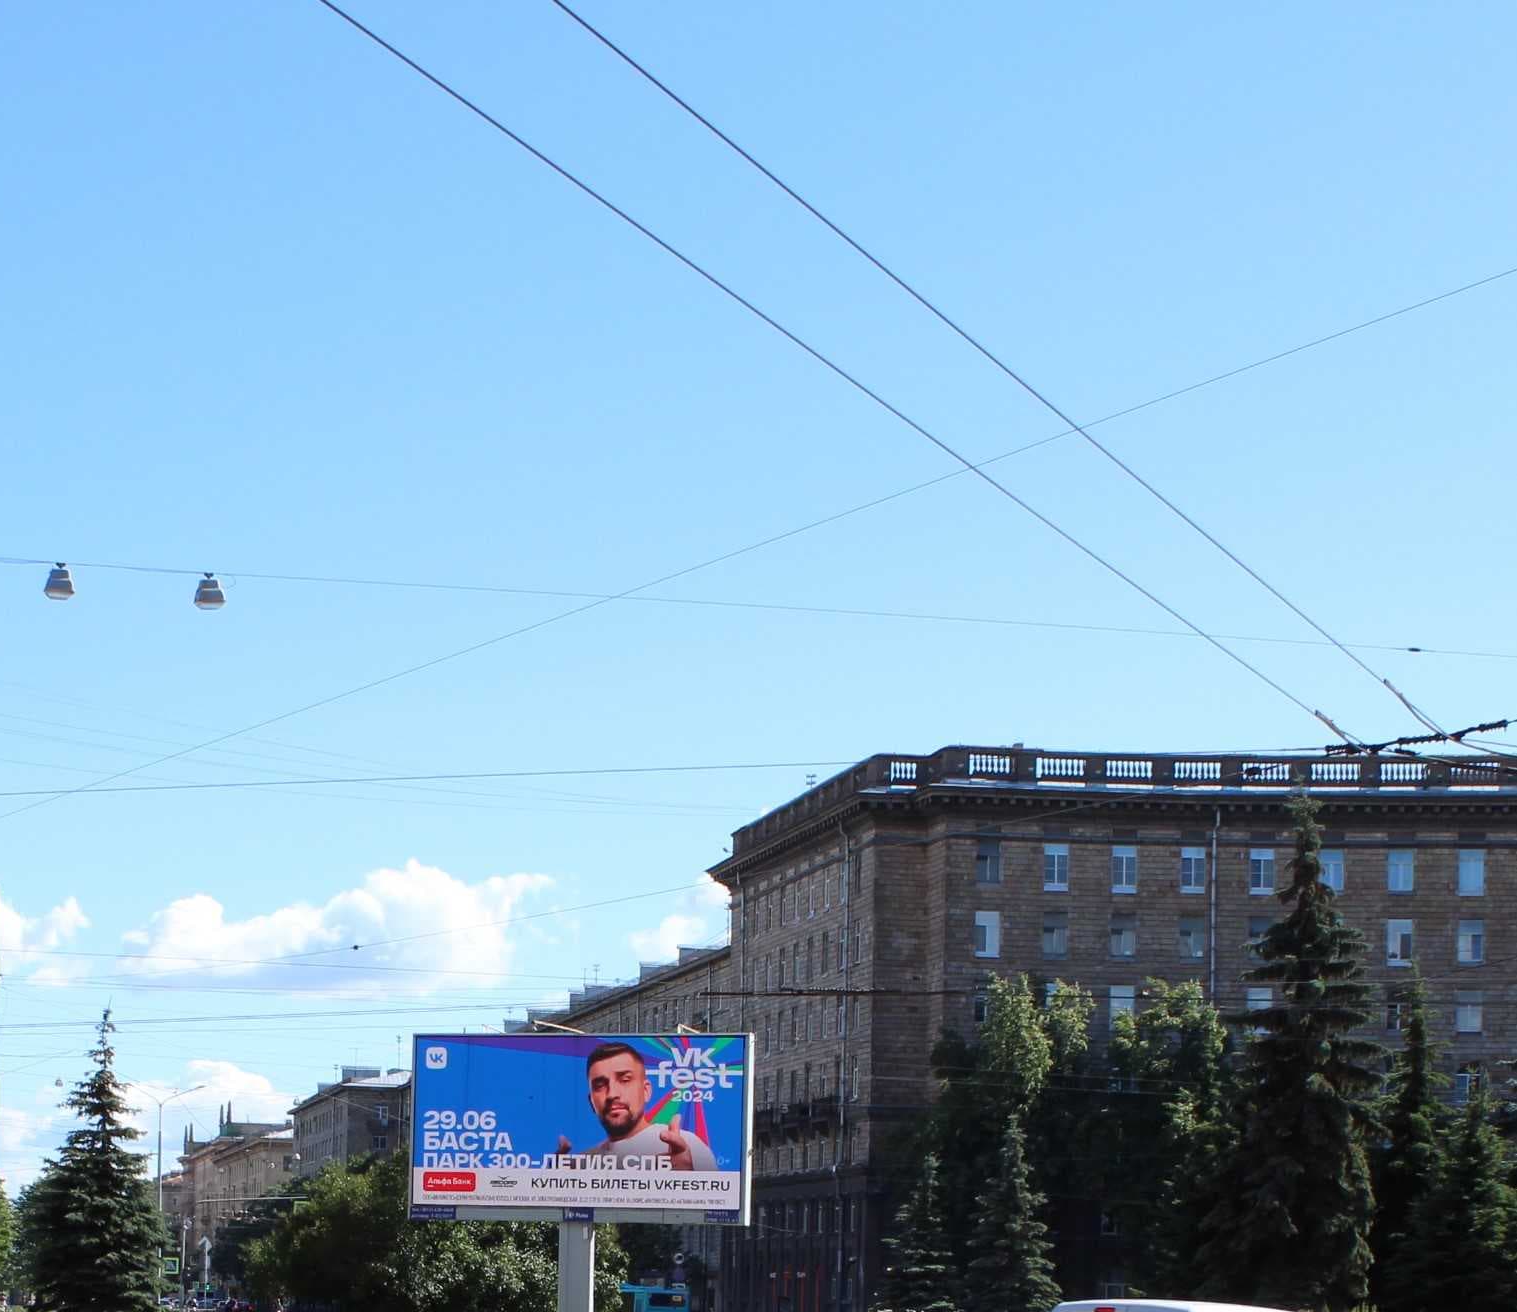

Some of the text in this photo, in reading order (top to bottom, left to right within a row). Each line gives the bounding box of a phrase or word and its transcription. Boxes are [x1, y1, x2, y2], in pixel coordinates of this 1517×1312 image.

[671, 1047, 716, 1068] VK
[658, 1061, 733, 1089] fest
[672, 1090, 714, 1103] 2024
[423, 1110, 497, 1130] 29.06
[424, 1131, 513, 1151] БАСТА
[424, 1152, 484, 1168] ПАРК
[623, 1154, 673, 1171] СПБ
[531, 1178, 731, 1191] КУПИТЬ БИЛЕТЫ VKFEST.RU
